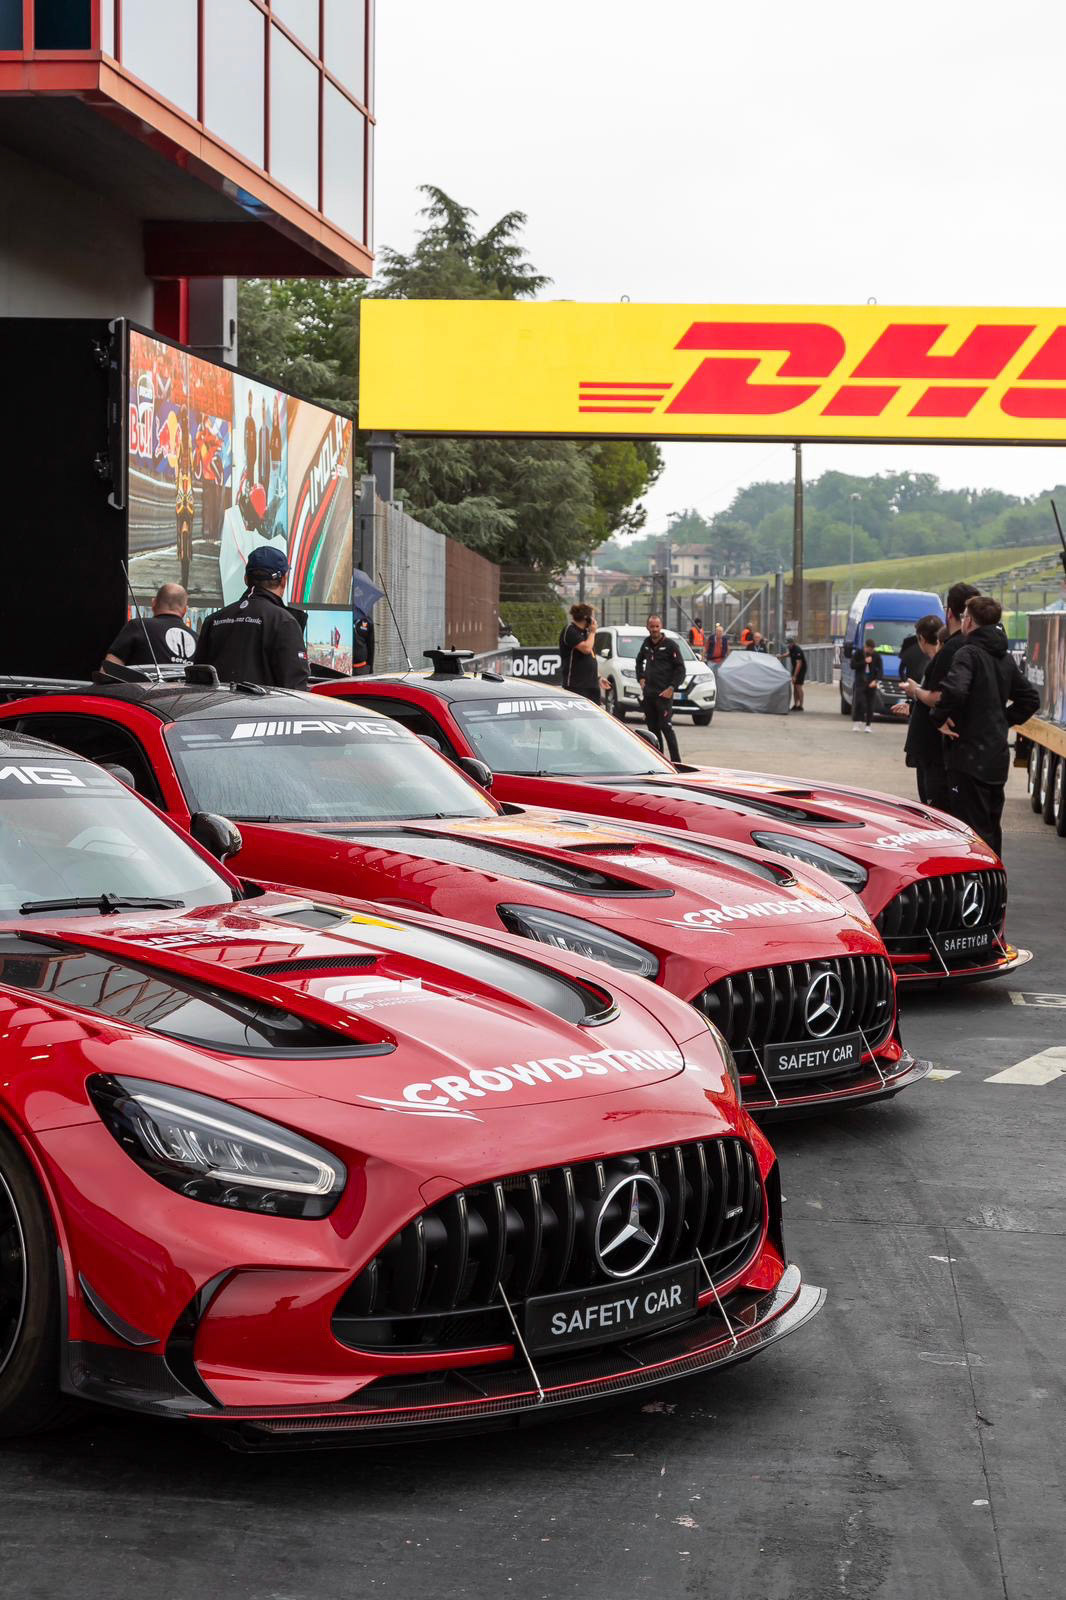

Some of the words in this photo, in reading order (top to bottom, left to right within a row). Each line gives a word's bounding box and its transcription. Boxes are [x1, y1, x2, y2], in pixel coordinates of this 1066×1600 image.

[293, 721, 398, 737] AMG
[944, 937, 976, 951] SAFETY
[977, 934, 988, 947] CAR
[778, 1050, 830, 1070] SAFETY
[832, 1045, 853, 1062] CAR
[551, 1297, 639, 1335] SAFETY
[644, 1285, 682, 1314] CAR
